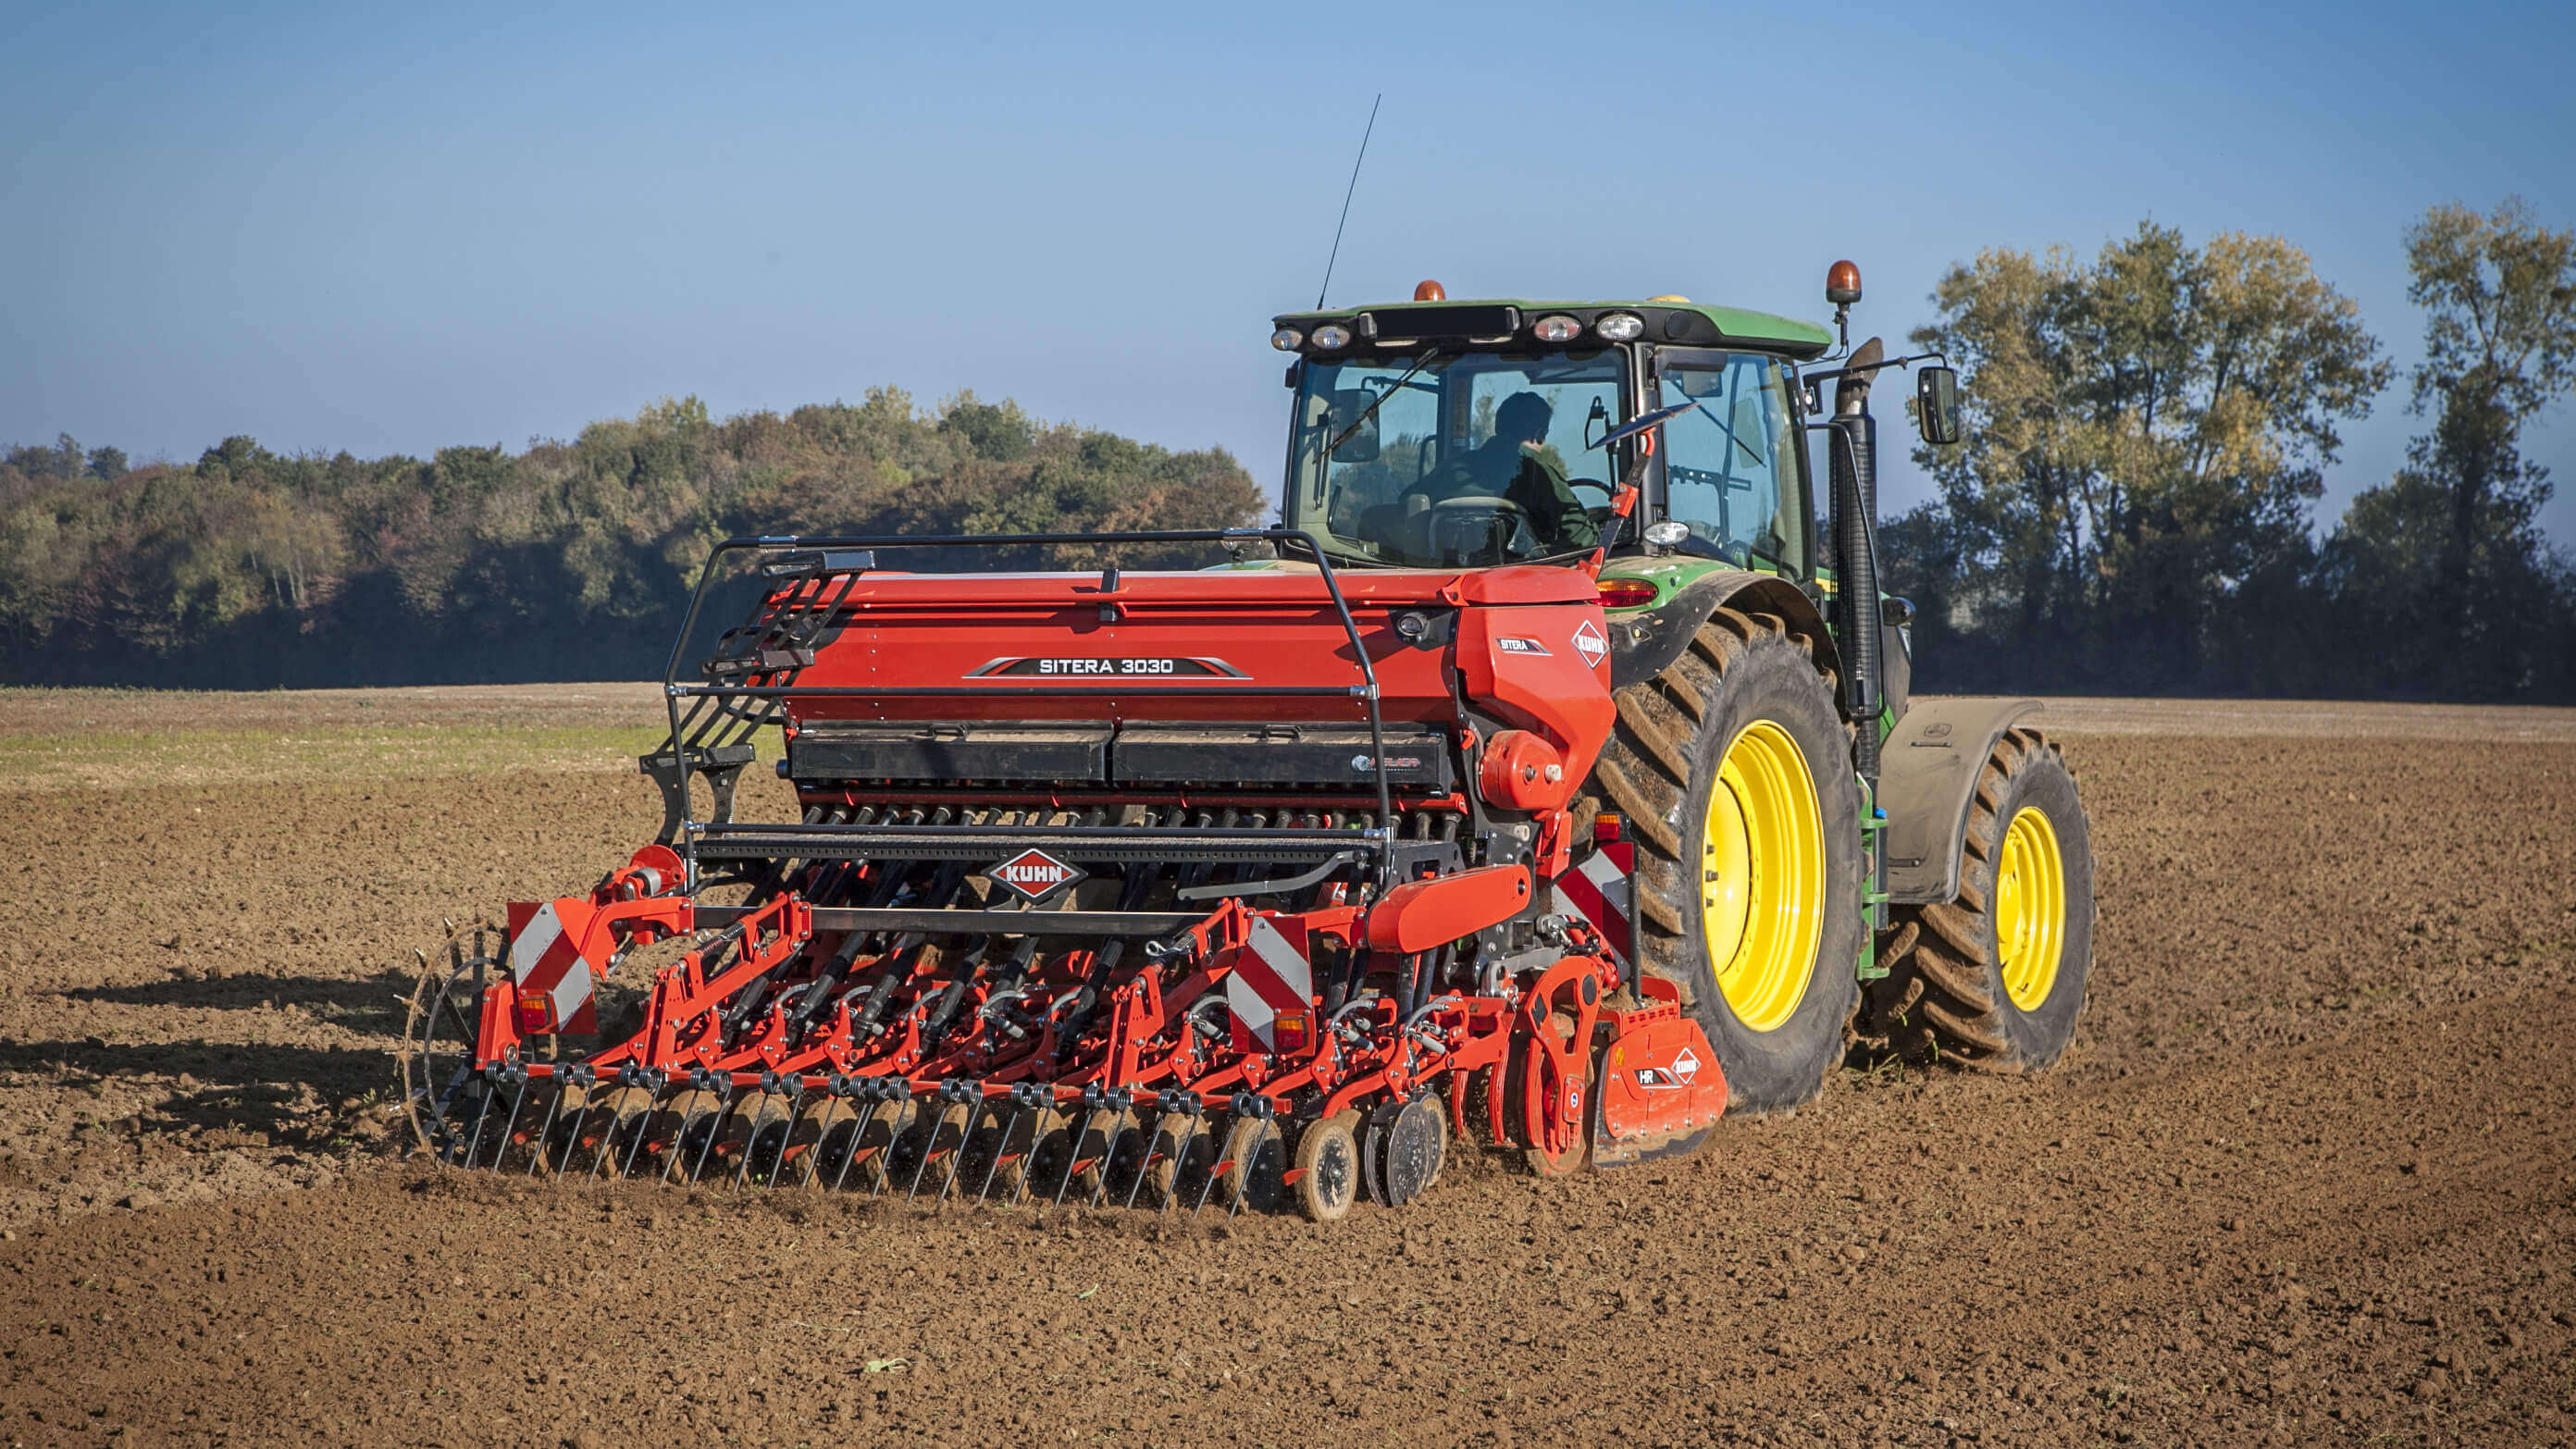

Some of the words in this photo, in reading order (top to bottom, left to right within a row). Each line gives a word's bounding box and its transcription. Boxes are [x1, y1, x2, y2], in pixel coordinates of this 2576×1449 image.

[1500, 638, 1529, 650] SITERA
[1578, 635, 1604, 654] KUHN
[1039, 659, 1114, 674] SITERA
[1121, 659, 1174, 674] 3030
[1006, 865, 1062, 882] KUHN
[1639, 1070, 1653, 1084] HR
